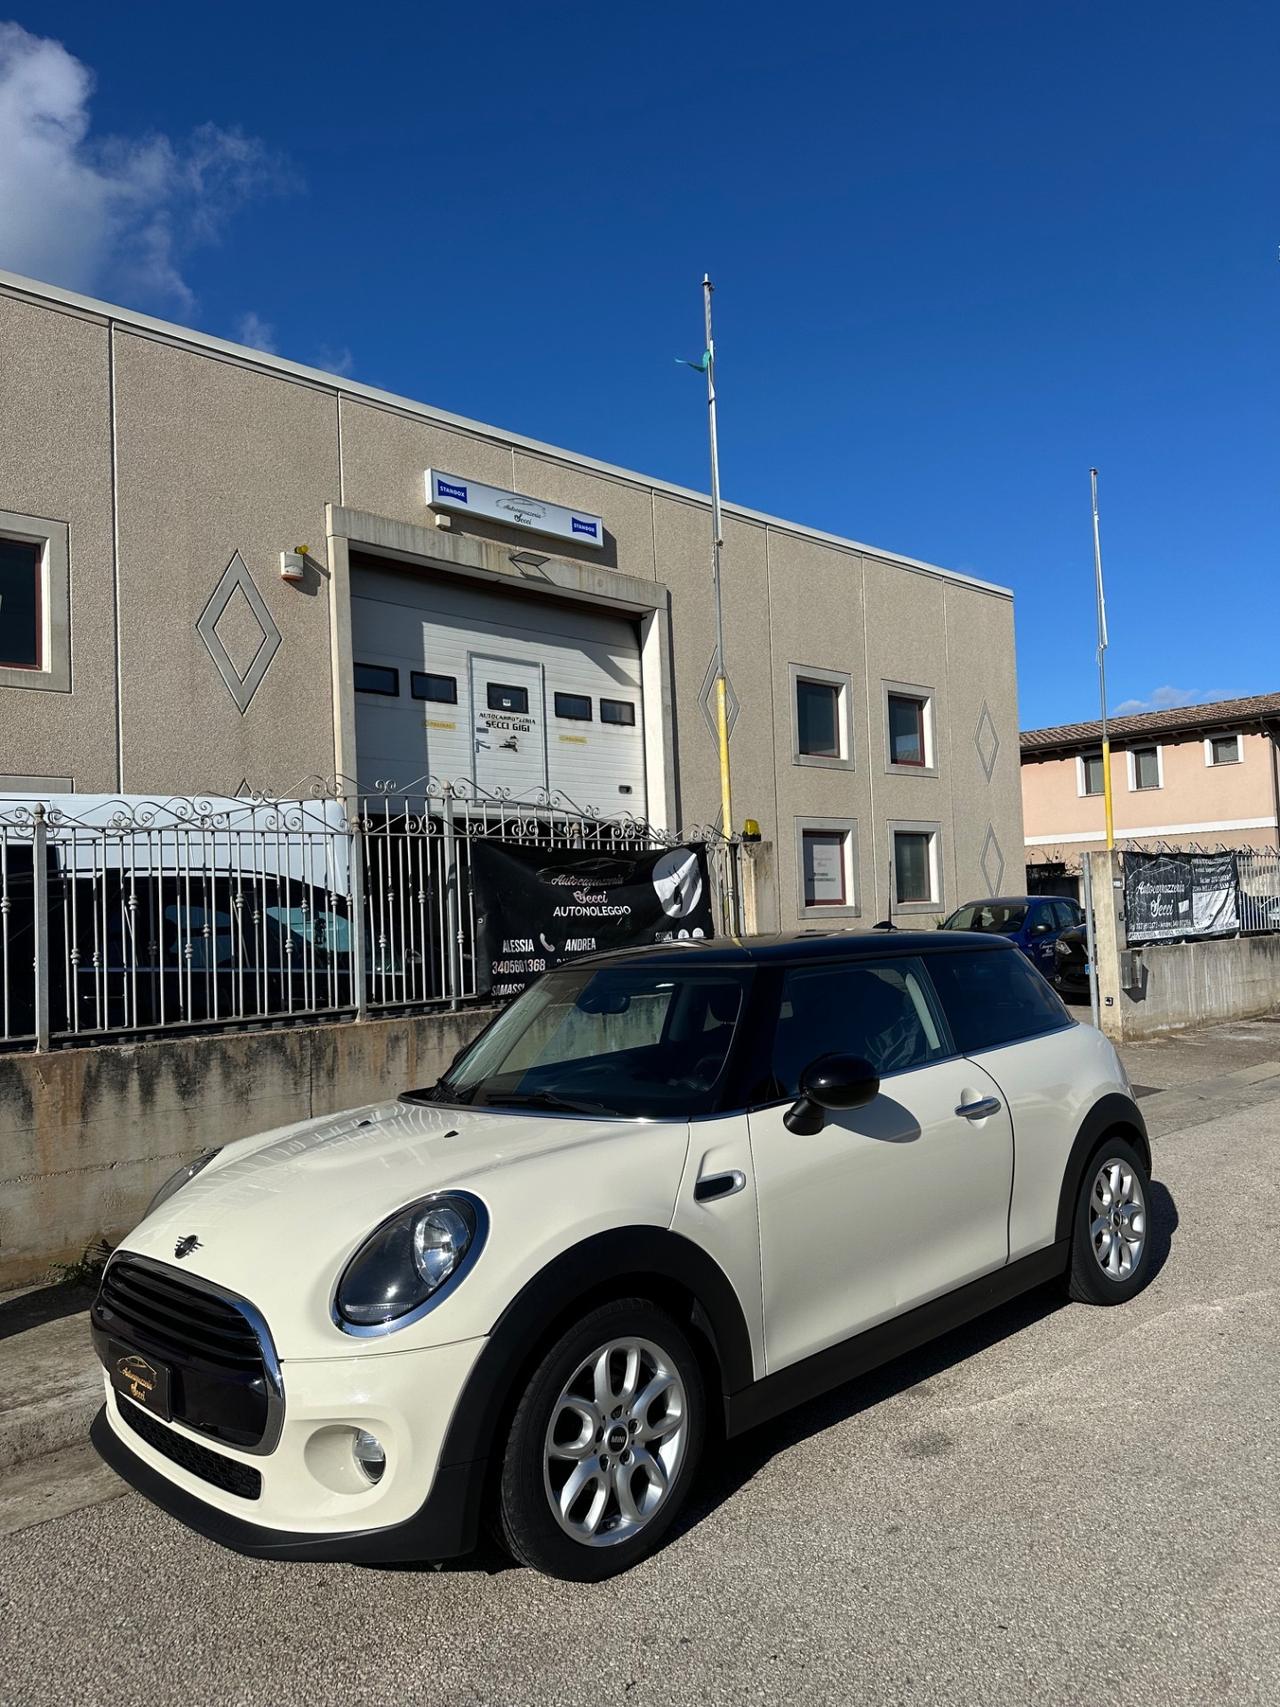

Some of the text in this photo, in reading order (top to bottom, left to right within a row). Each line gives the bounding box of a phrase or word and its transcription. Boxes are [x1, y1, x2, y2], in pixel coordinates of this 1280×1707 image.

[440, 485, 465, 498] STANDOX
[485, 720, 530, 732] SECCI GIGI
[553, 905, 631, 917] AUTONOLEGGIO
[502, 939, 535, 953] ALESSIA
[564, 937, 597, 951] ANDREA
